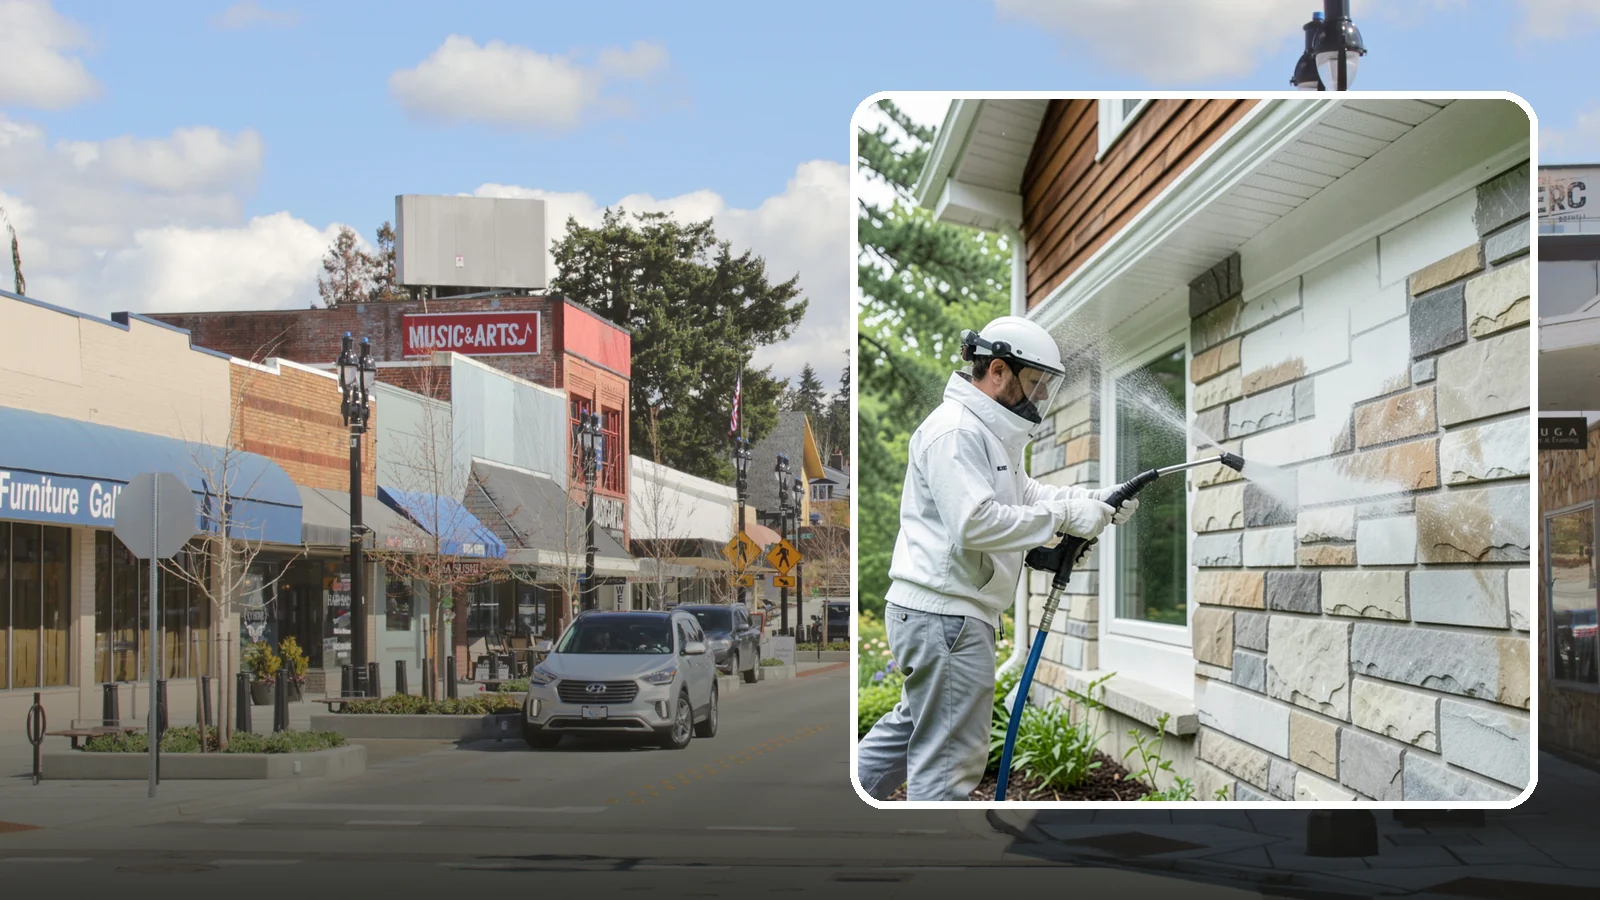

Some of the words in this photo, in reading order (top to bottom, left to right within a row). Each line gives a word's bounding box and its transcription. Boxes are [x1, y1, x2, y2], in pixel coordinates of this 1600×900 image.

[0, 471, 79, 515] Furniture
[89, 482, 122, 519] Gal
[453, 563, 479, 574] SUSHI
